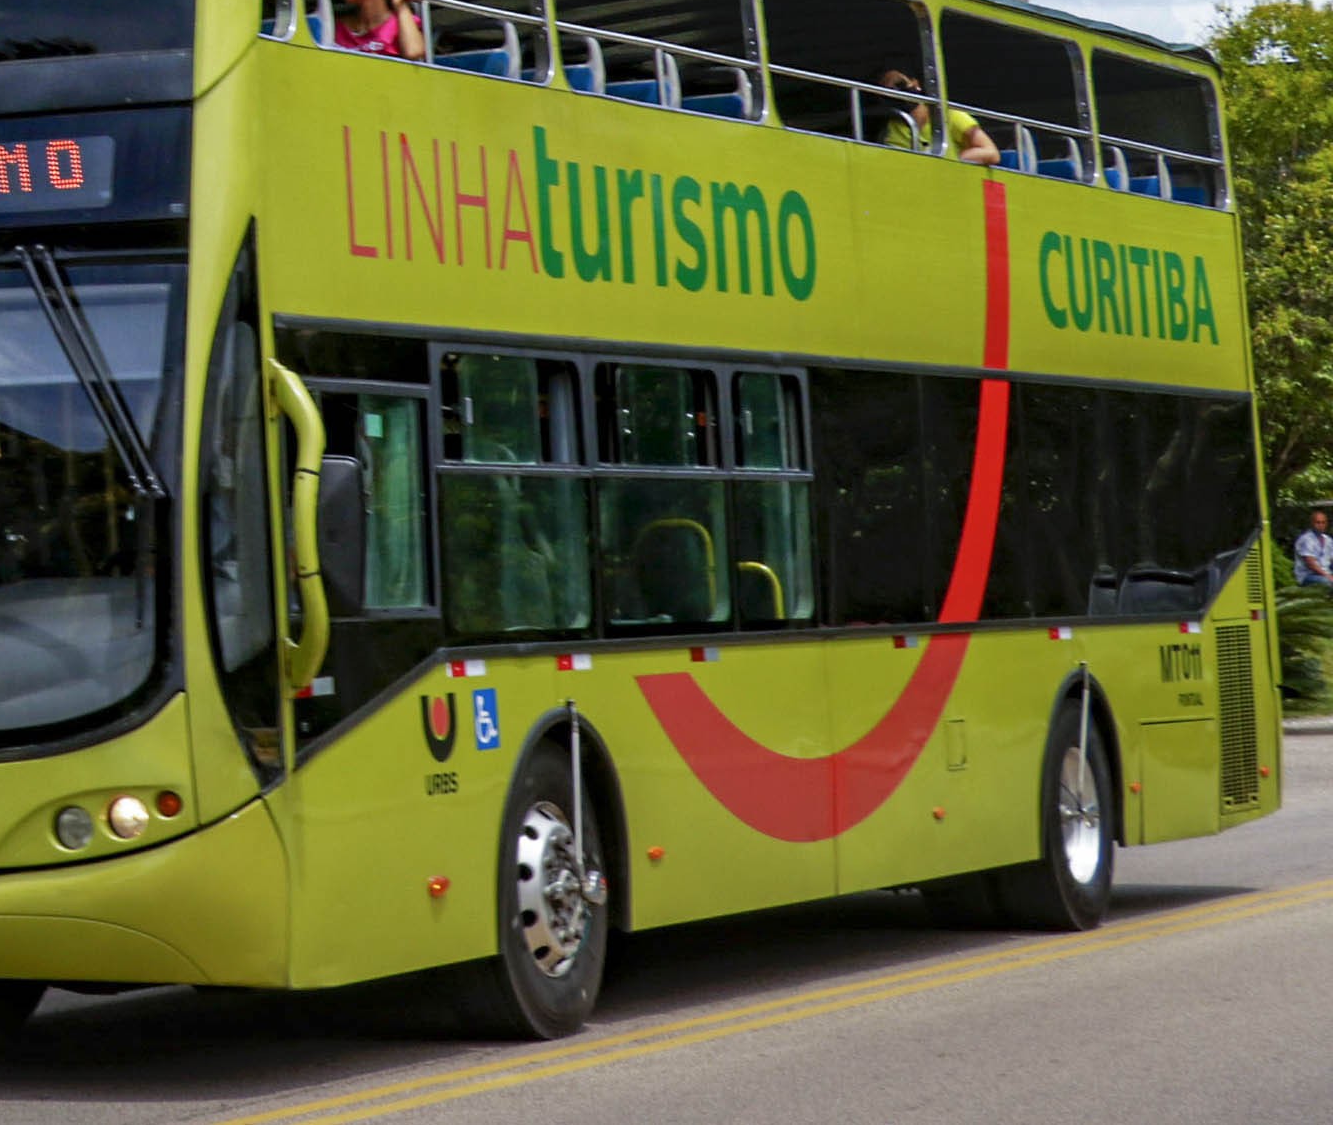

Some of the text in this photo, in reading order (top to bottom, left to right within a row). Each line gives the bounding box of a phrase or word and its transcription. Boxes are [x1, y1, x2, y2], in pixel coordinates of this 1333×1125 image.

[342, 125, 817, 302] LINHA turismo
[1039, 230, 1220, 346] CURITIBA
